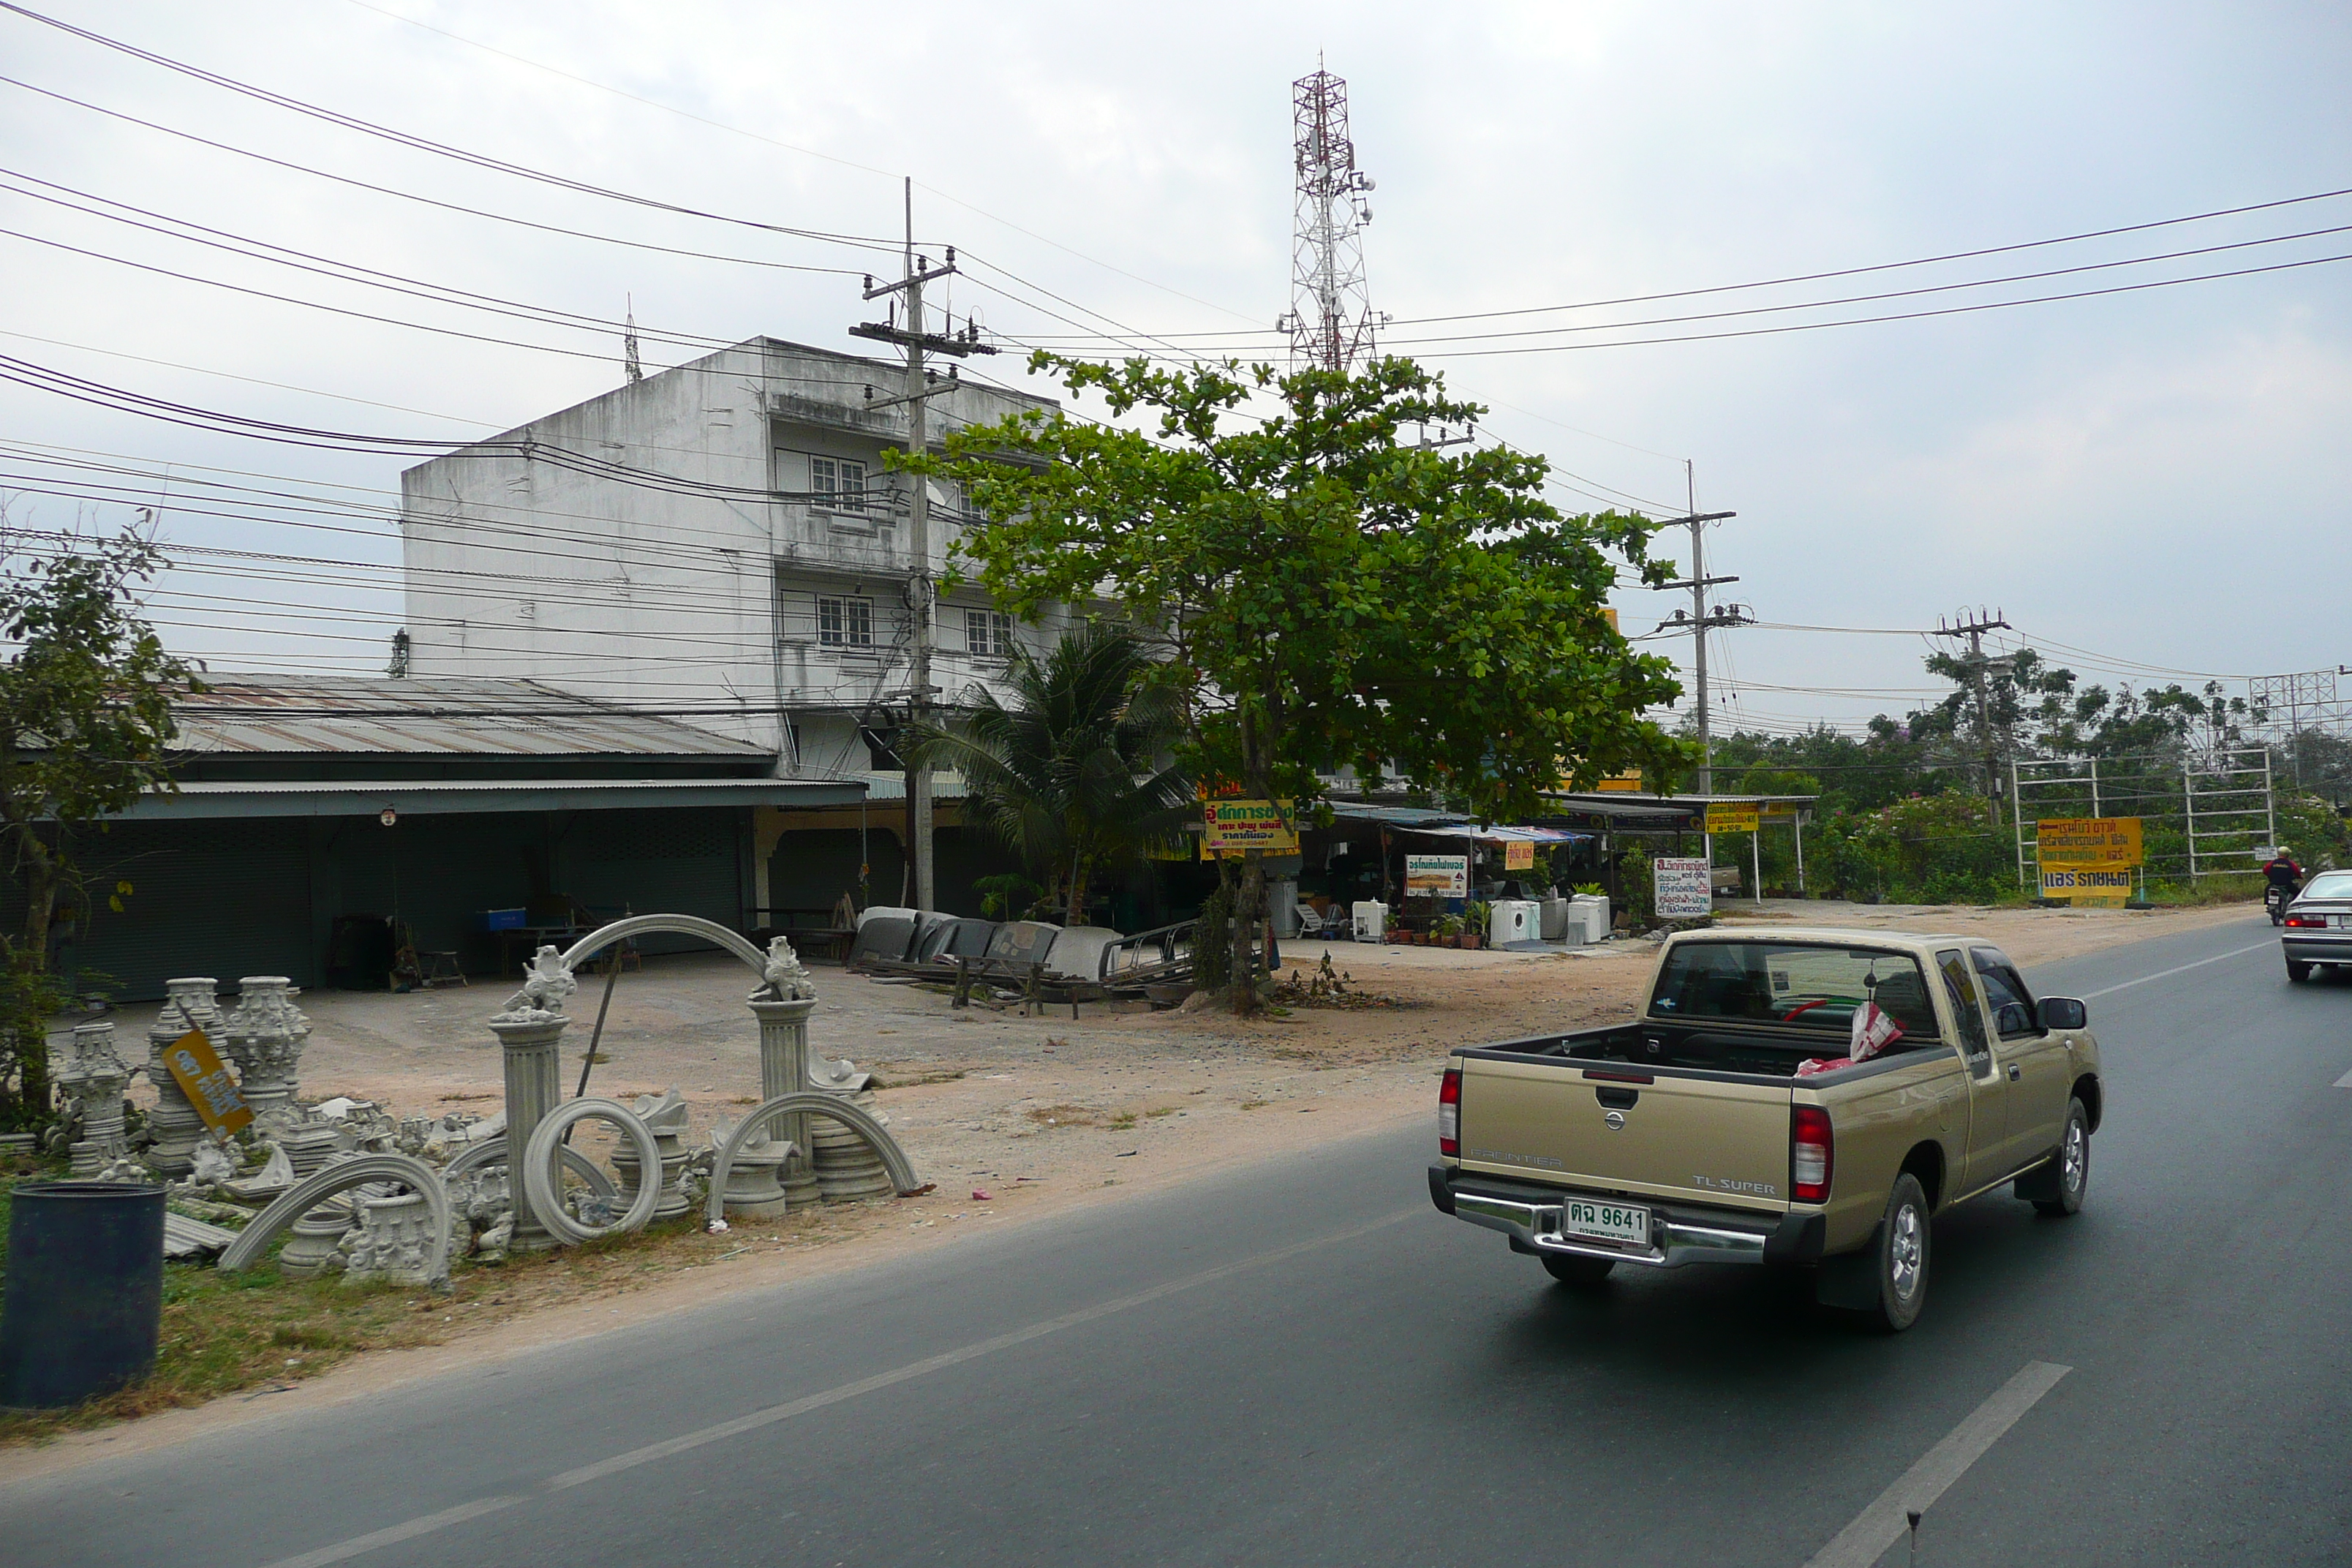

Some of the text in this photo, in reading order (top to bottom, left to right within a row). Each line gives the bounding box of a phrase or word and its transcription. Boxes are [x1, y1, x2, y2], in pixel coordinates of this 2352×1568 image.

[1222, 830, 1274, 840] ราคากันเอง
[2106, 848, 2124, 860] แอร์
[2044, 867, 2130, 887] แอร์ รถยนต์
[1471, 1148, 1562, 1168] FRONTIER
[1692, 1175, 1776, 1195] TL SUPER
[1571, 1203, 1642, 1231] ตฉ 9641
[1579, 1227, 1635, 1241] กรงเทพมหานคร
